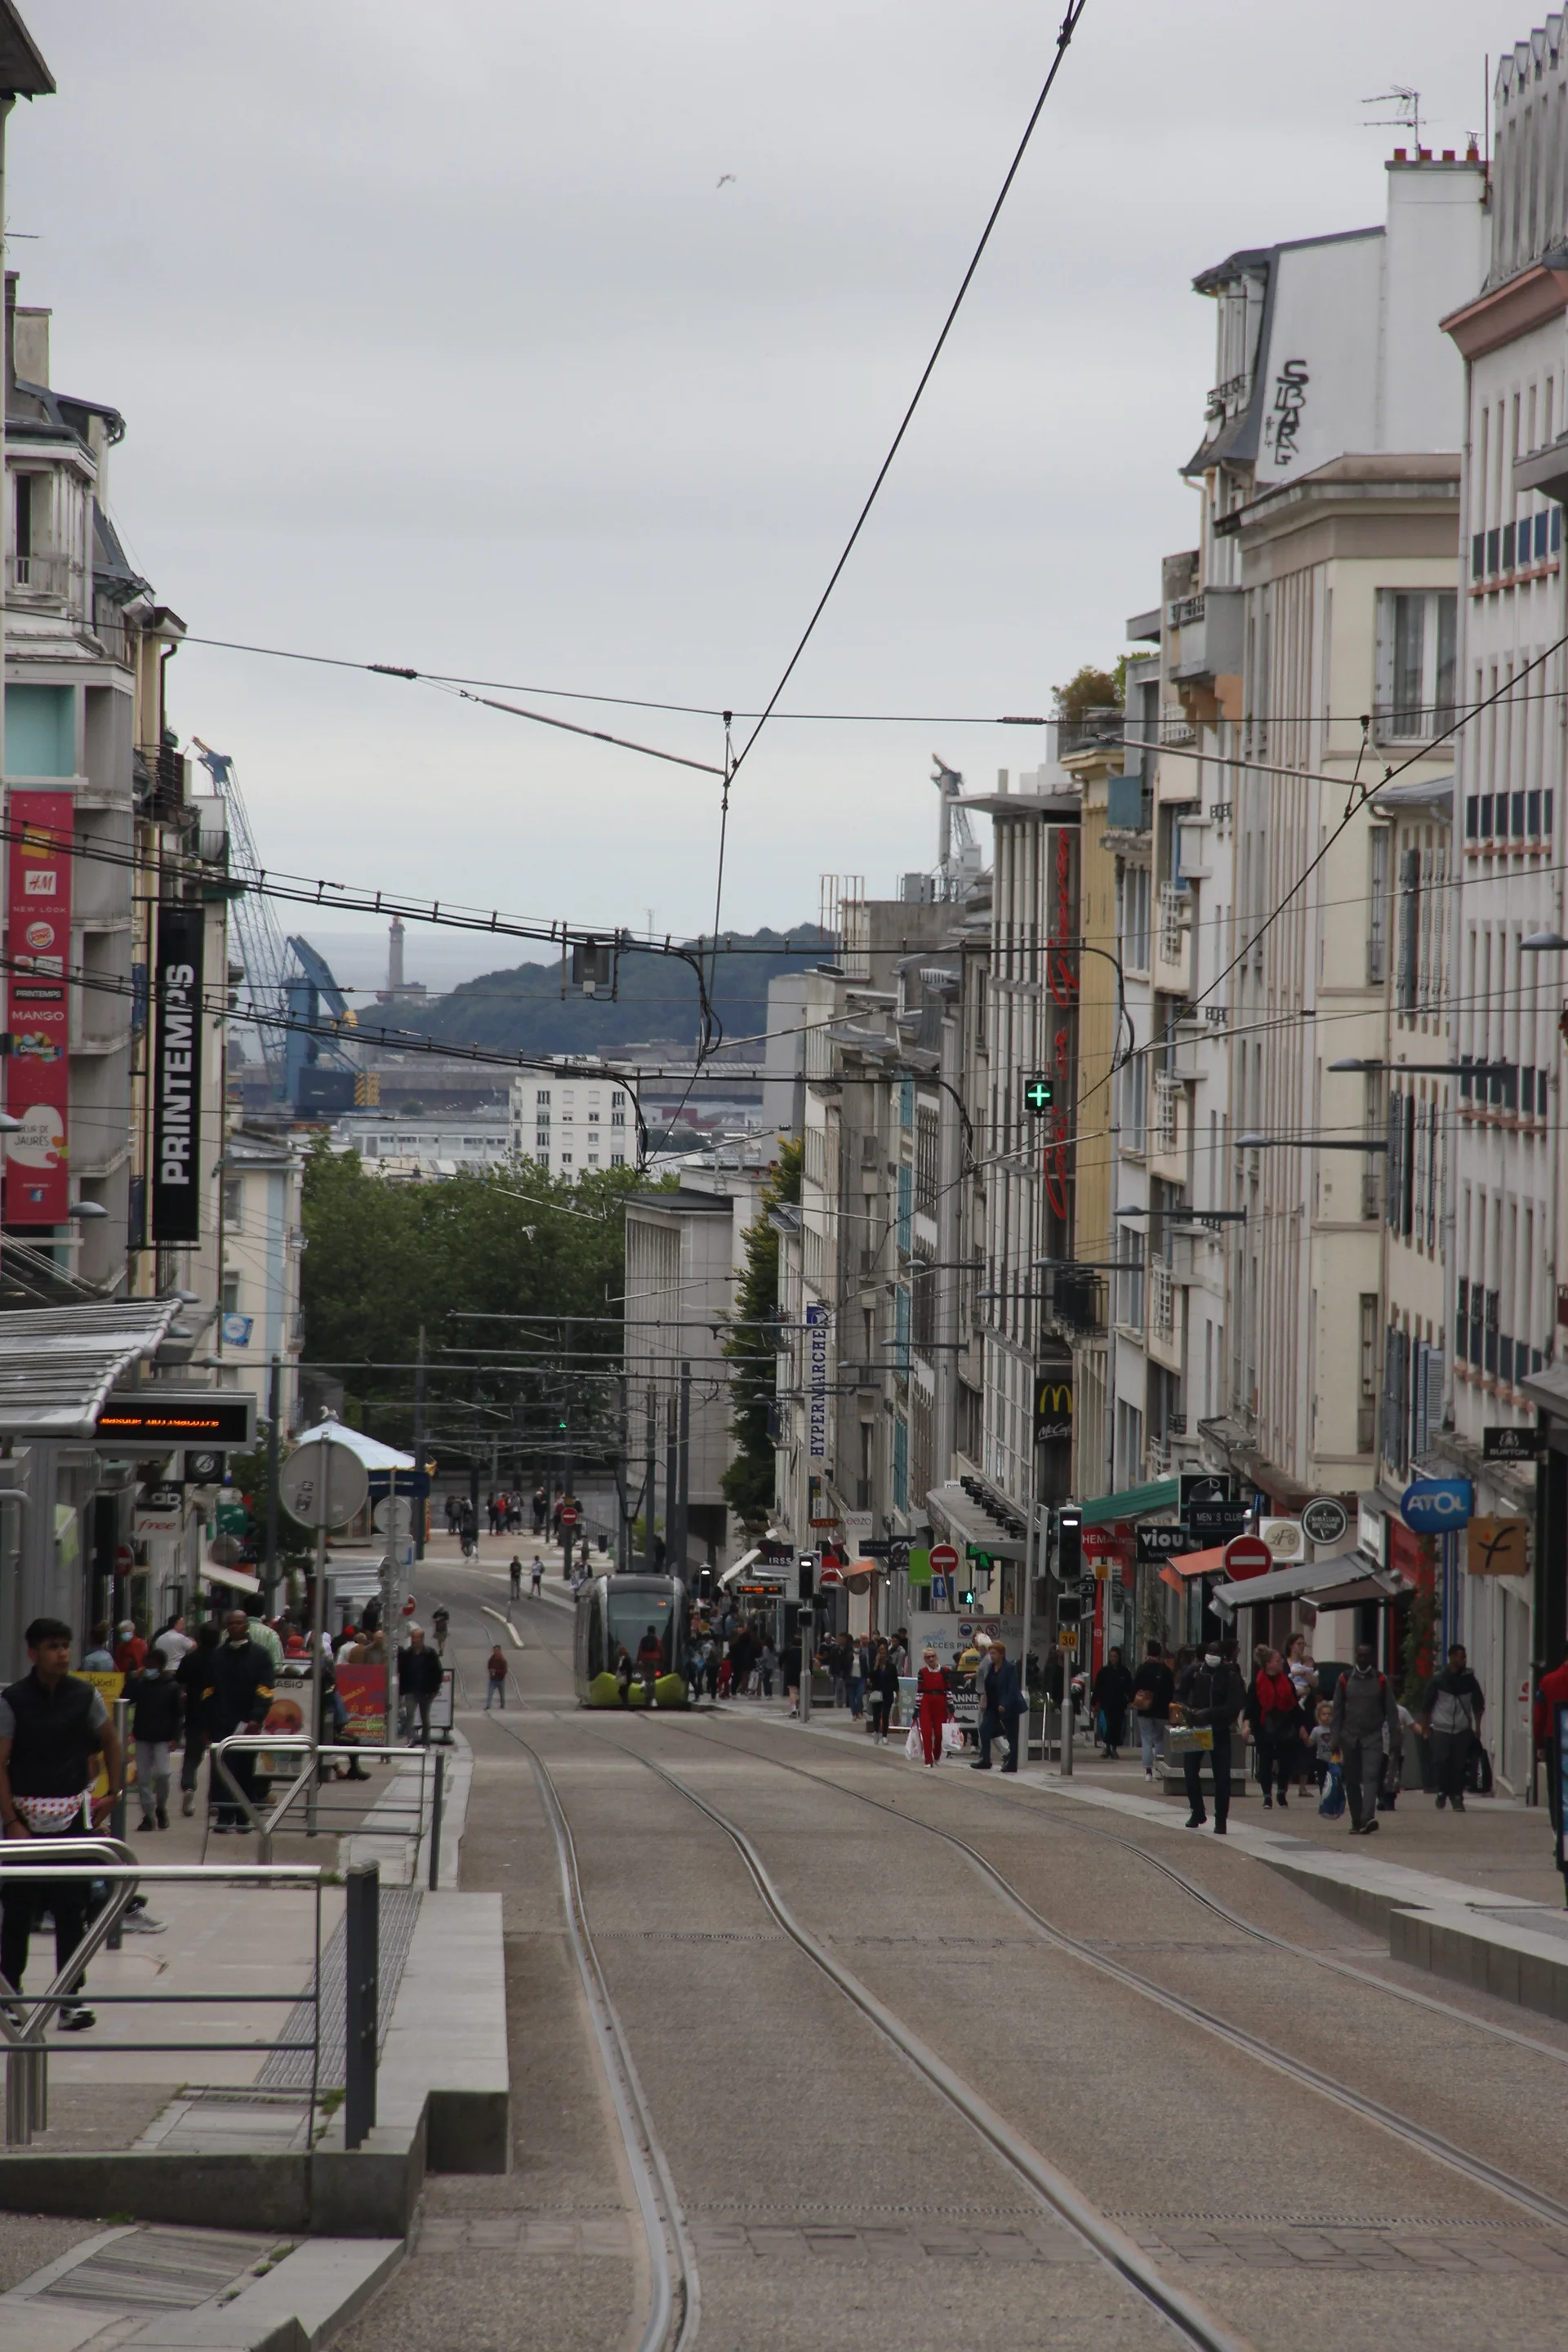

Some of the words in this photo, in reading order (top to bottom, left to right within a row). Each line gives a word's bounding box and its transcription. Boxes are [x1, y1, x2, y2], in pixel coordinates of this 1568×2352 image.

[16, 989, 61, 998] PRINTEMPS
[12, 1011, 65, 1021] MANGO
[161, 964, 195, 1185] PRINTEMPS
[1407, 1491, 1468, 1514] ATOL
[1224, 1512, 1242, 1521] CLUB
[137, 1519, 176, 1533] free
[1141, 1529, 1183, 1548] viou
[768, 1557, 791, 1566] IRSS
[927, 1642, 955, 1650] ACCES
[1062, 1636, 1076, 1646] 30
